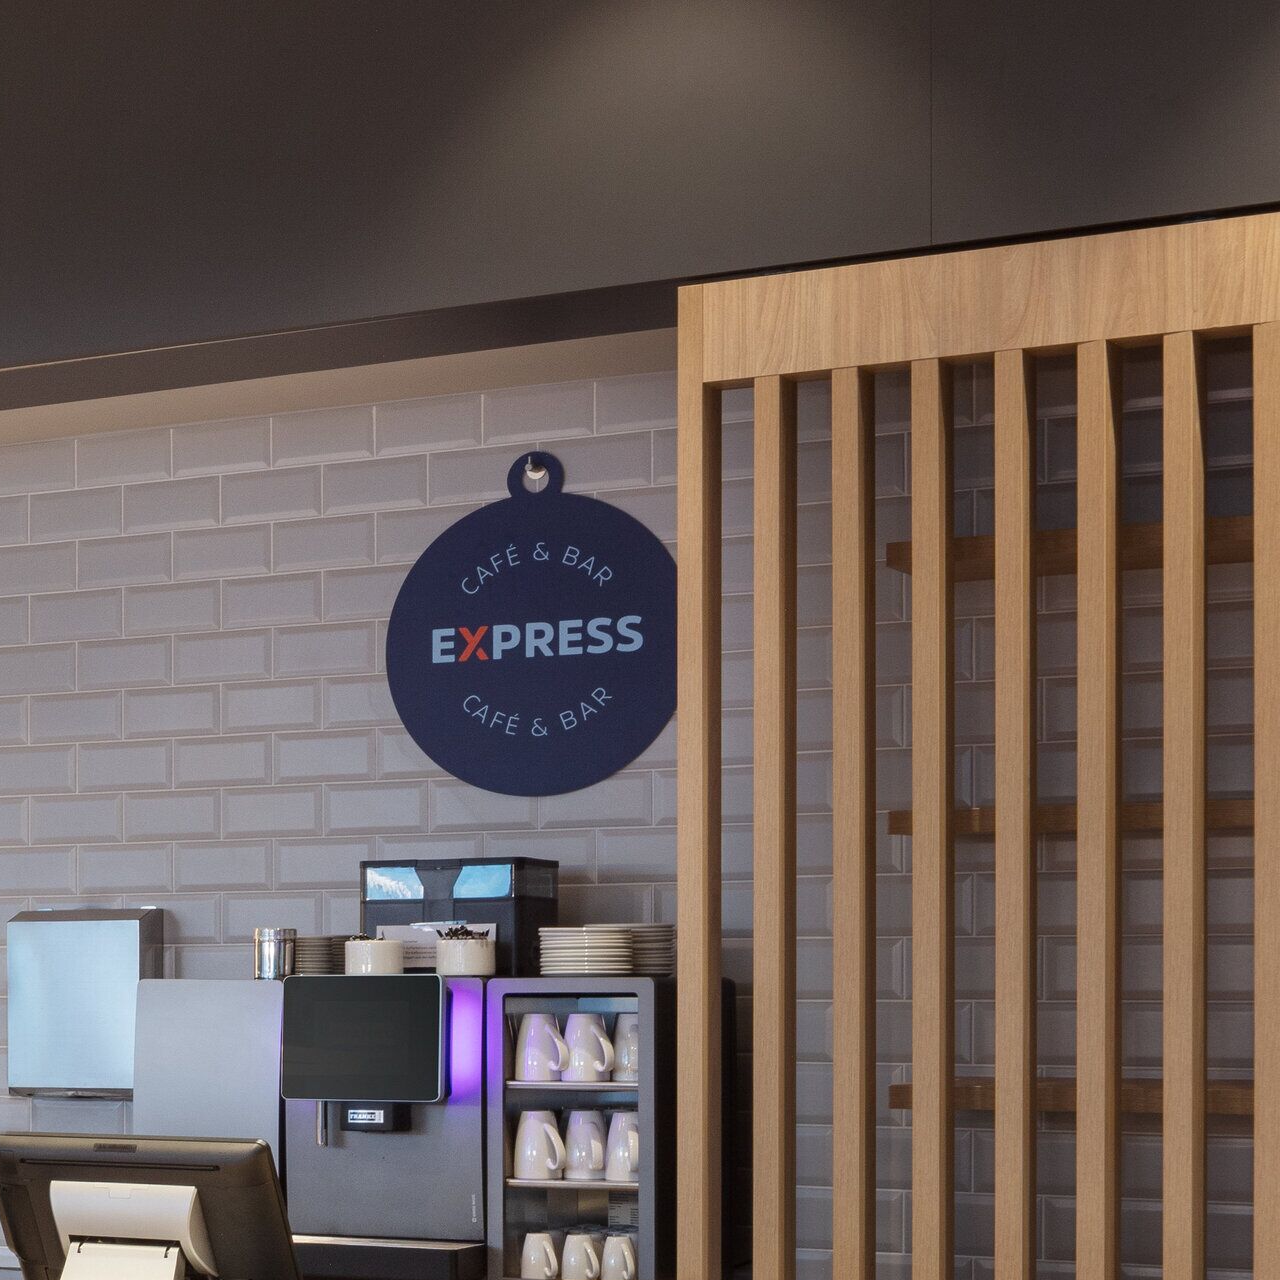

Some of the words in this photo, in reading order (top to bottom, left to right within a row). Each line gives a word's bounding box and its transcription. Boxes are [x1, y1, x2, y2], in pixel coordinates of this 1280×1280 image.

[461, 543, 521, 595] CAFÉ
[532, 542, 549, 561] &
[562, 546, 613, 587] BAR
[432, 615, 644, 664] EXPRESS
[462, 694, 521, 735] CAFÉ
[530, 717, 548, 737] &
[559, 687, 613, 730] BAR
